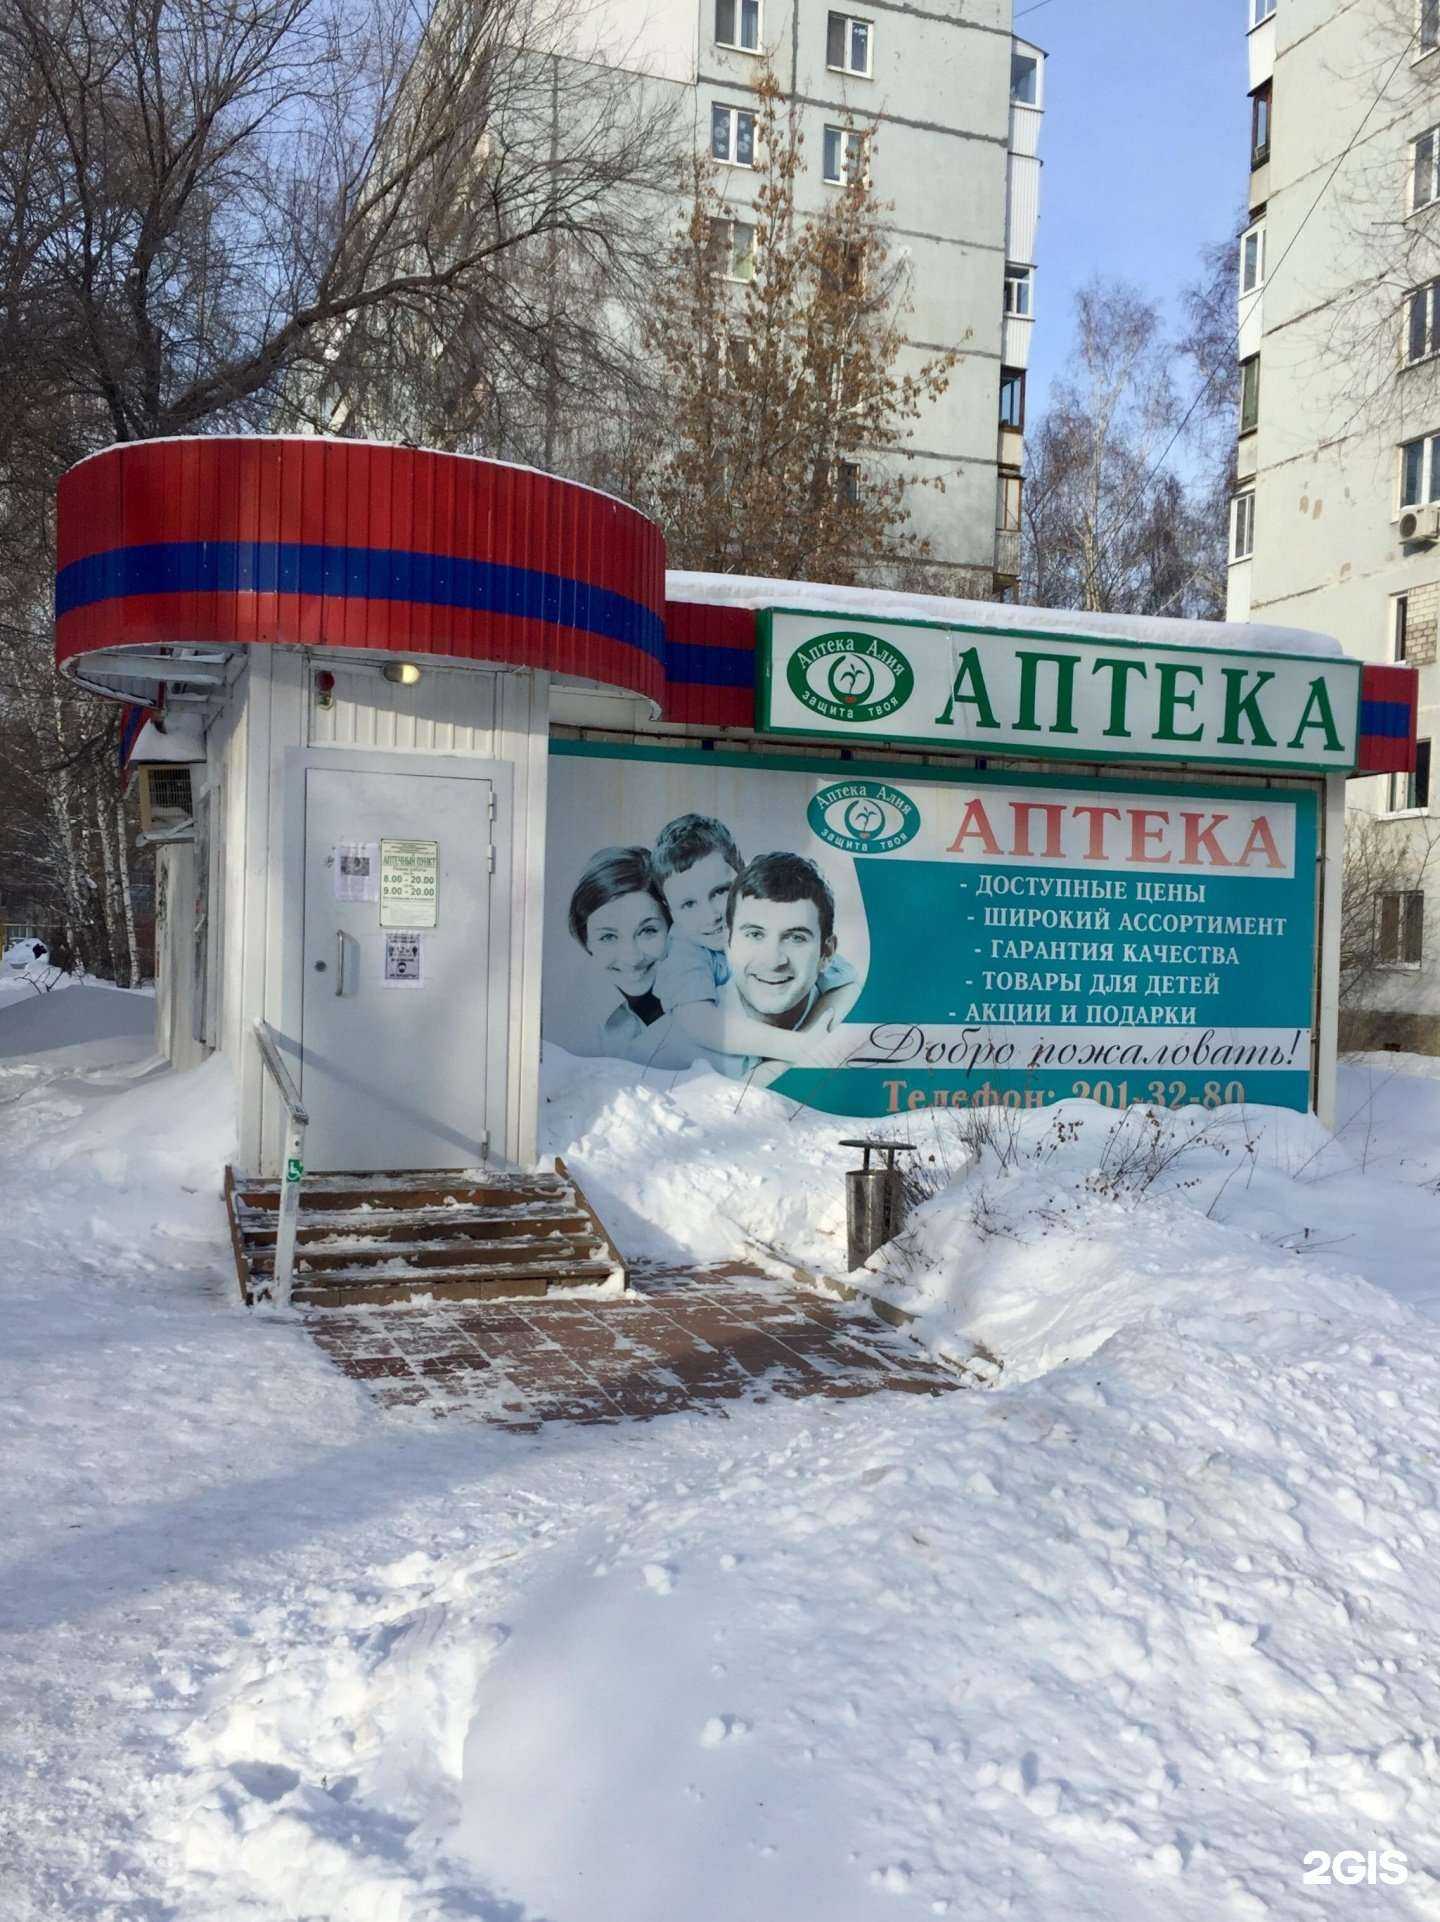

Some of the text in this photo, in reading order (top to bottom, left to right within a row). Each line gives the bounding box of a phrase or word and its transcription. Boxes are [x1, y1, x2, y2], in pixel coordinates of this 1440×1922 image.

[797, 638, 905, 676] Аптека Алия
[802, 690, 898, 718] защита твоя
[935, 647, 1346, 751] АПТЕКА
[816, 785, 912, 815] Аптека Алия
[821, 829, 908, 851] защита твоя
[946, 798, 1288, 869] АПТЕКА
[411, 876, 434, 884] 20.00
[411, 887, 435, 896] 20.00
[976, 874, 1128, 899] ДОСТУПНЫЕ
[1135, 882, 1207, 904] ЦЕНЫ
[983, 906, 1111, 931] ШИРОКИЙ
[1118, 913, 1287, 936] АССОРТИМЕНТ
[990, 939, 1114, 962] ГАРАНТИЯ
[1122, 943, 1240, 965] КАЧЕСТВА
[982, 970, 1082, 993] ТОВАРЫ
[1089, 974, 1138, 996] ДЛЯ
[1144, 972, 1220, 996] ДЕТЕЙ
[965, 1003, 1051, 1025] АКЦИИ
[1060, 1004, 1078, 1023] И
[1086, 1004, 1197, 1027] ПОДАРКИ
[847, 1023, 1301, 1078] Добро пожаловать!
